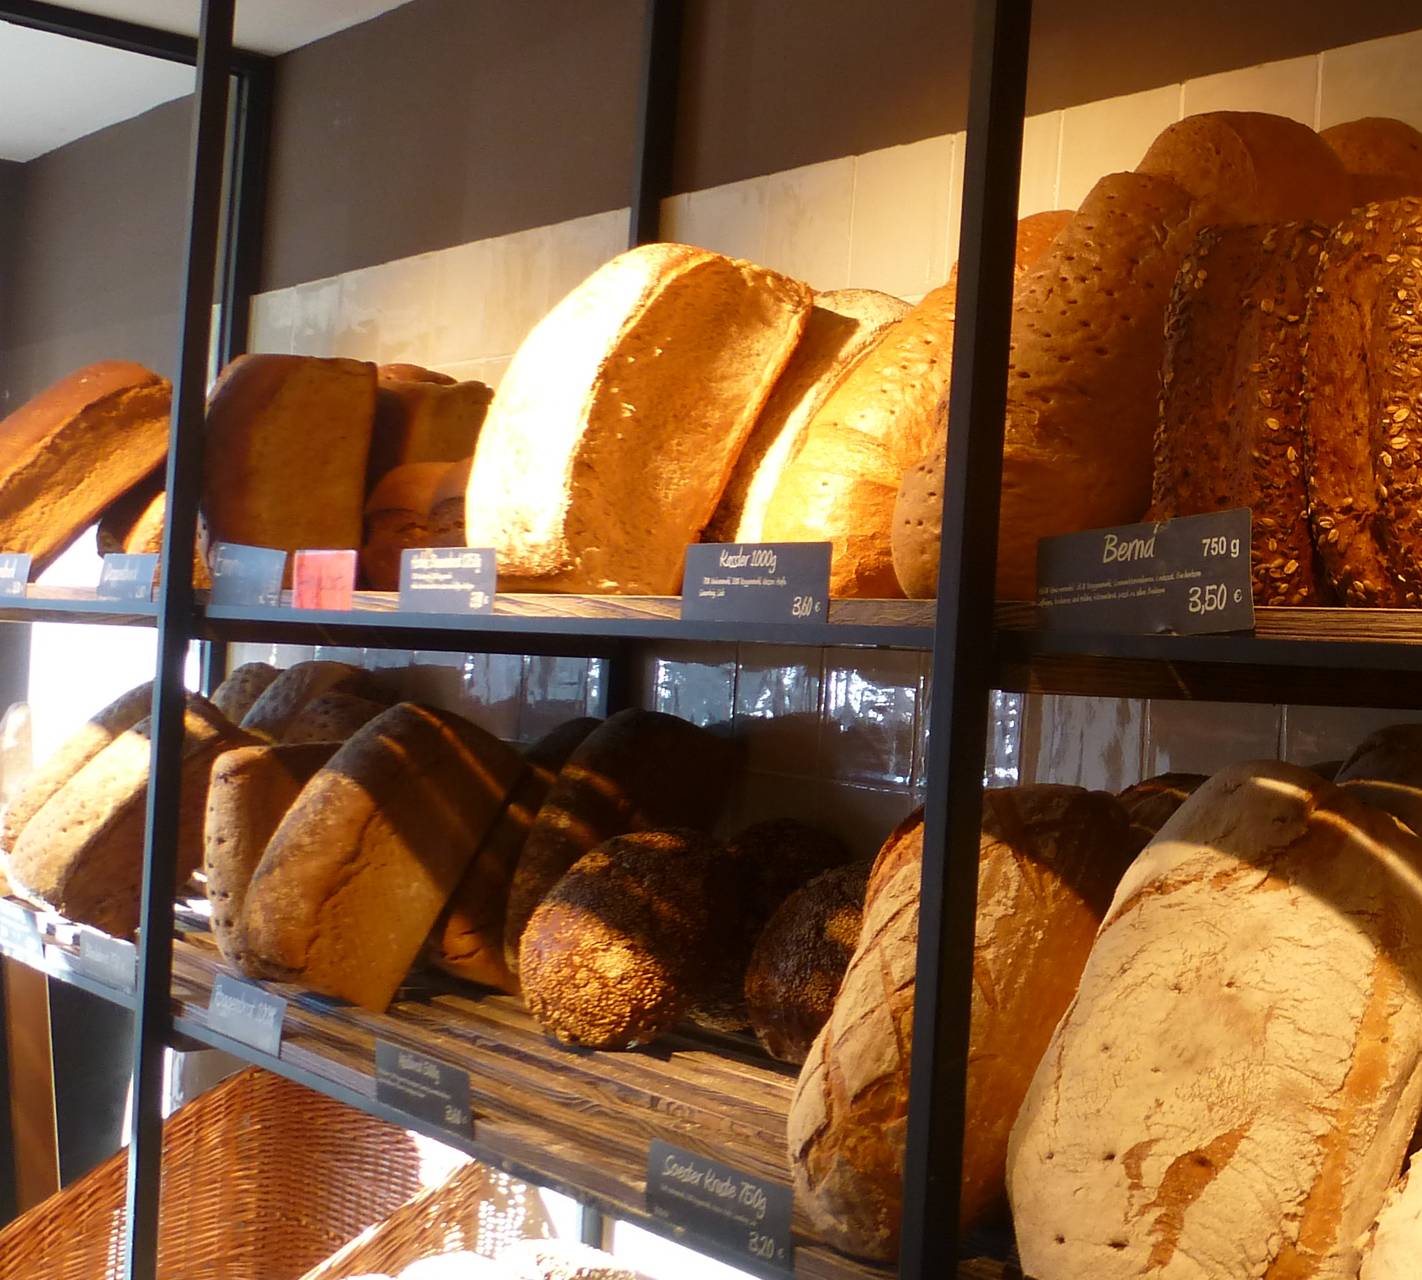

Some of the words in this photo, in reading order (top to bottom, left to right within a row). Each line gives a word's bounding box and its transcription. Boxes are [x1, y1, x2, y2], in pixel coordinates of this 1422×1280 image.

[1103, 522, 1160, 564] Bernd
[1202, 536, 1227, 557] 750
[1230, 538, 1240, 559] g
[1188, 583, 1227, 615] 3,50
[1233, 588, 1243, 603] €
[738, 1181, 767, 1220] 750g
